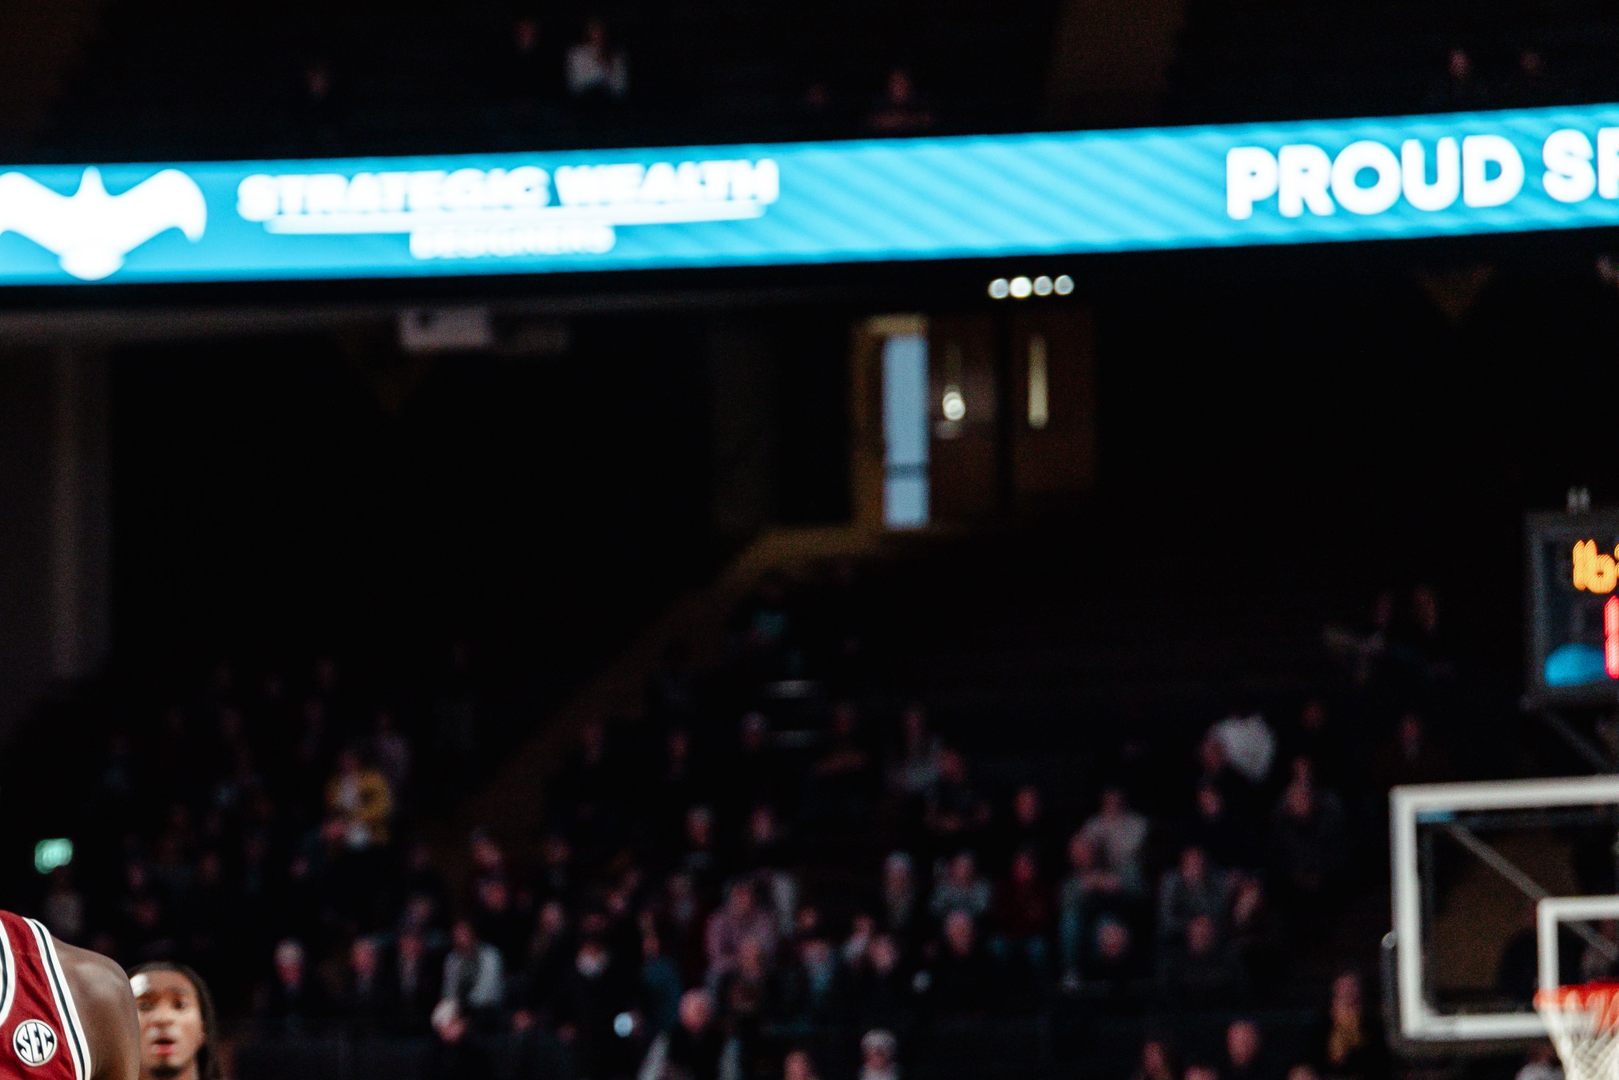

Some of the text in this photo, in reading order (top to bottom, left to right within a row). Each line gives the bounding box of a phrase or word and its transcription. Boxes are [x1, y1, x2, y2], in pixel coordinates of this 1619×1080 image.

[237, 158, 779, 222] STRATEGIC WEALTH
[1227, 135, 1525, 220] PROUD
[16, 1022, 54, 1063] SEC
